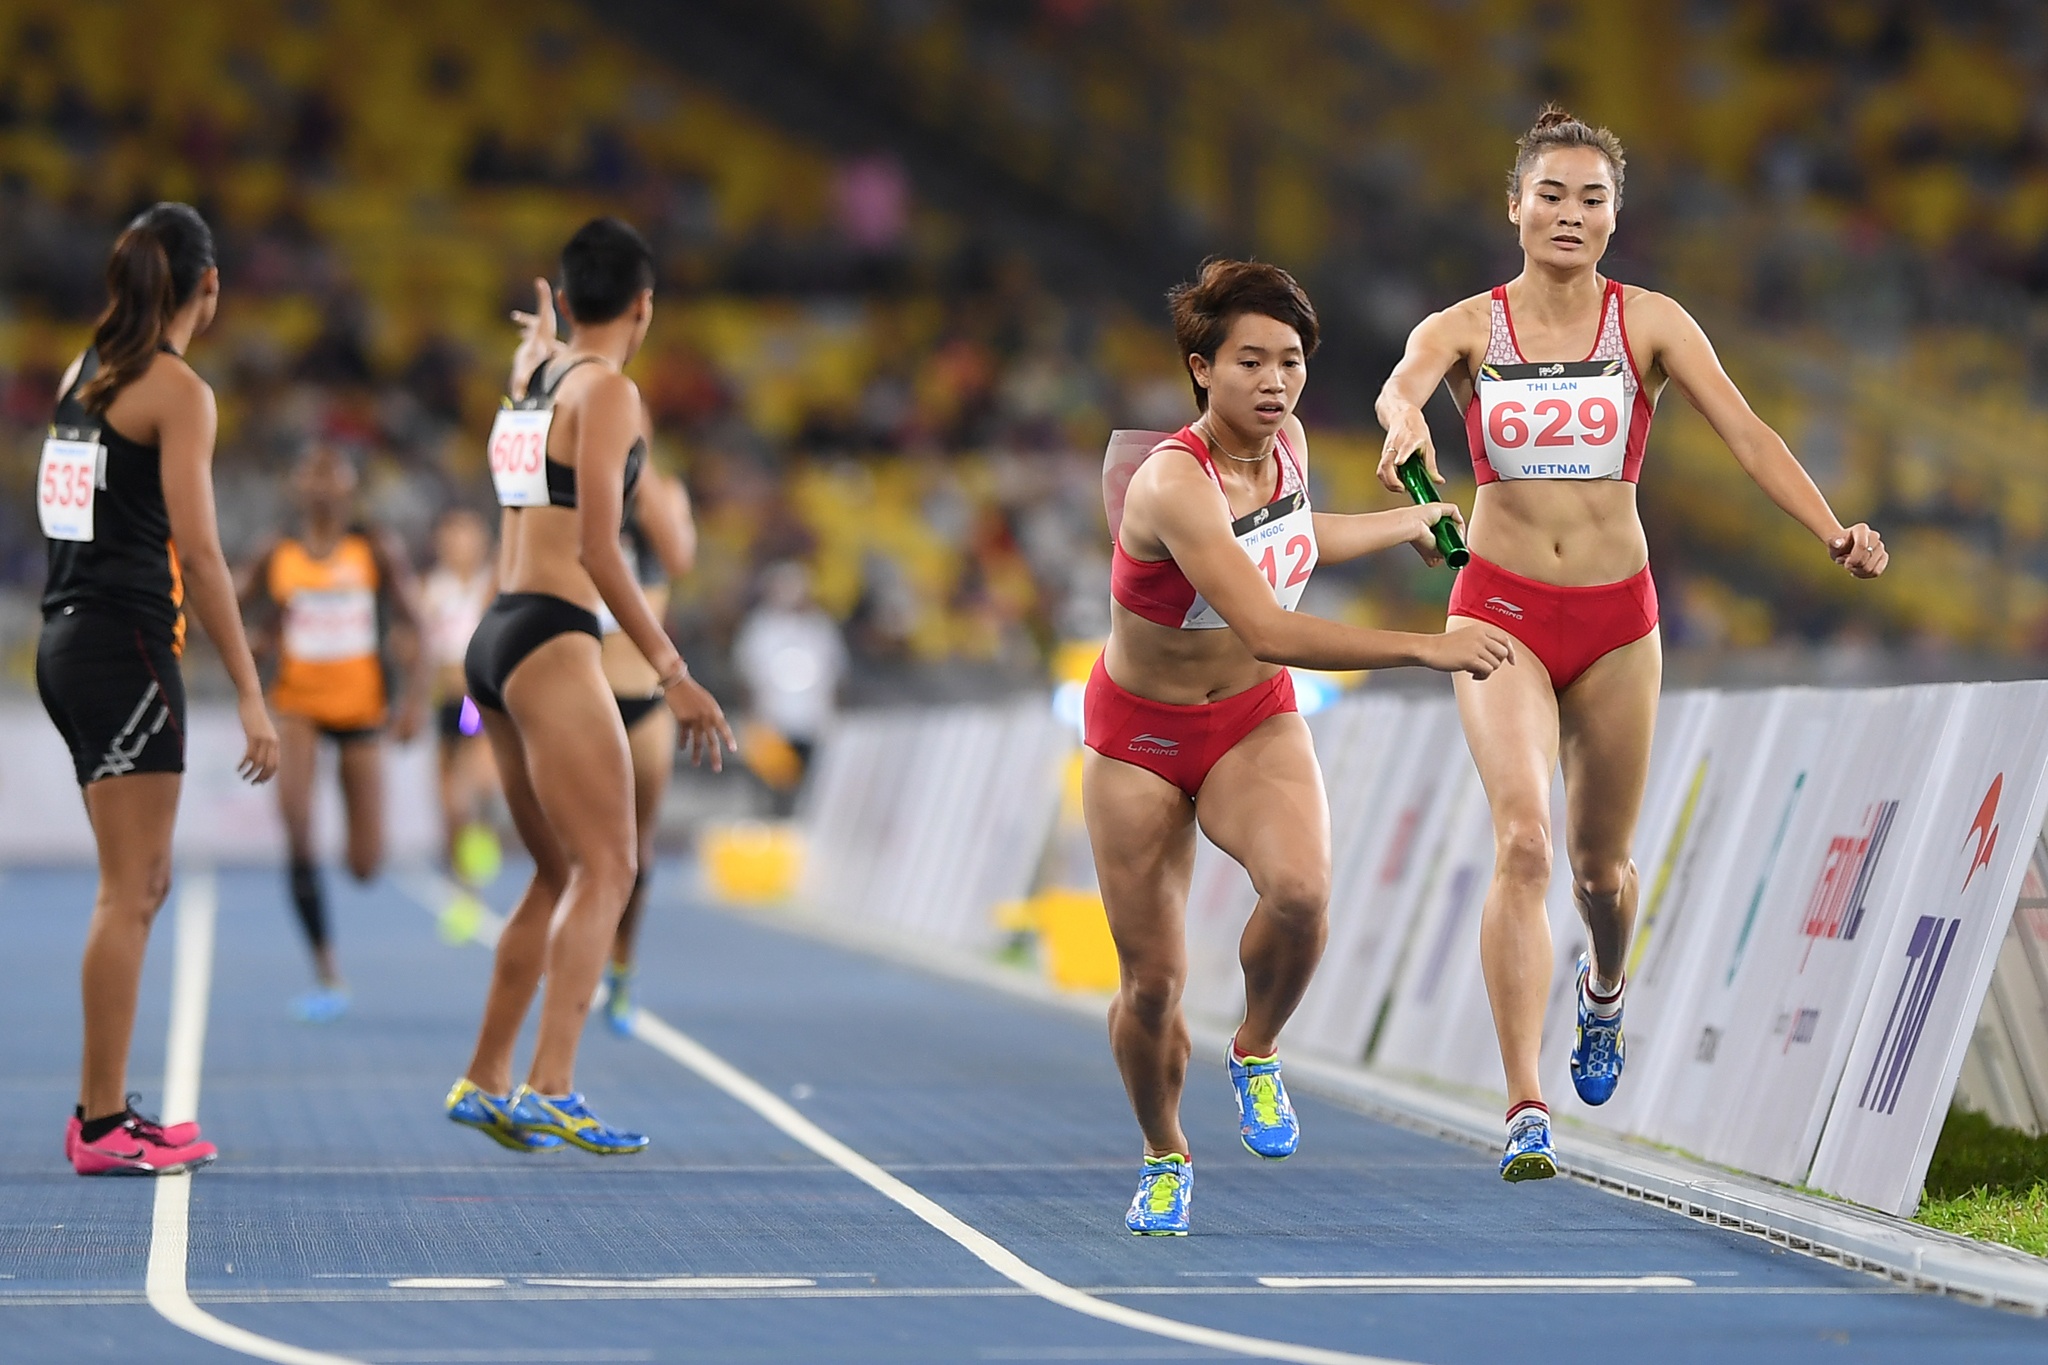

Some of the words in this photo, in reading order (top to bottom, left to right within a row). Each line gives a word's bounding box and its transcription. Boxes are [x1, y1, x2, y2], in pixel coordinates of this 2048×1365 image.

[1526, 383, 1548, 392] THI
[1552, 382, 1578, 391] LAN
[1488, 397, 1619, 449] 629
[490, 432, 543, 475] 603
[1521, 464, 1591, 475] VIETNAM
[43, 463, 92, 508] 535
[1244, 534, 1260, 548] THI
[1260, 523, 1285, 541] NGOC
[1257, 534, 1312, 591] 12
[1127, 743, 1179, 756] LI-NING
[1858, 914, 1962, 1116] TM
